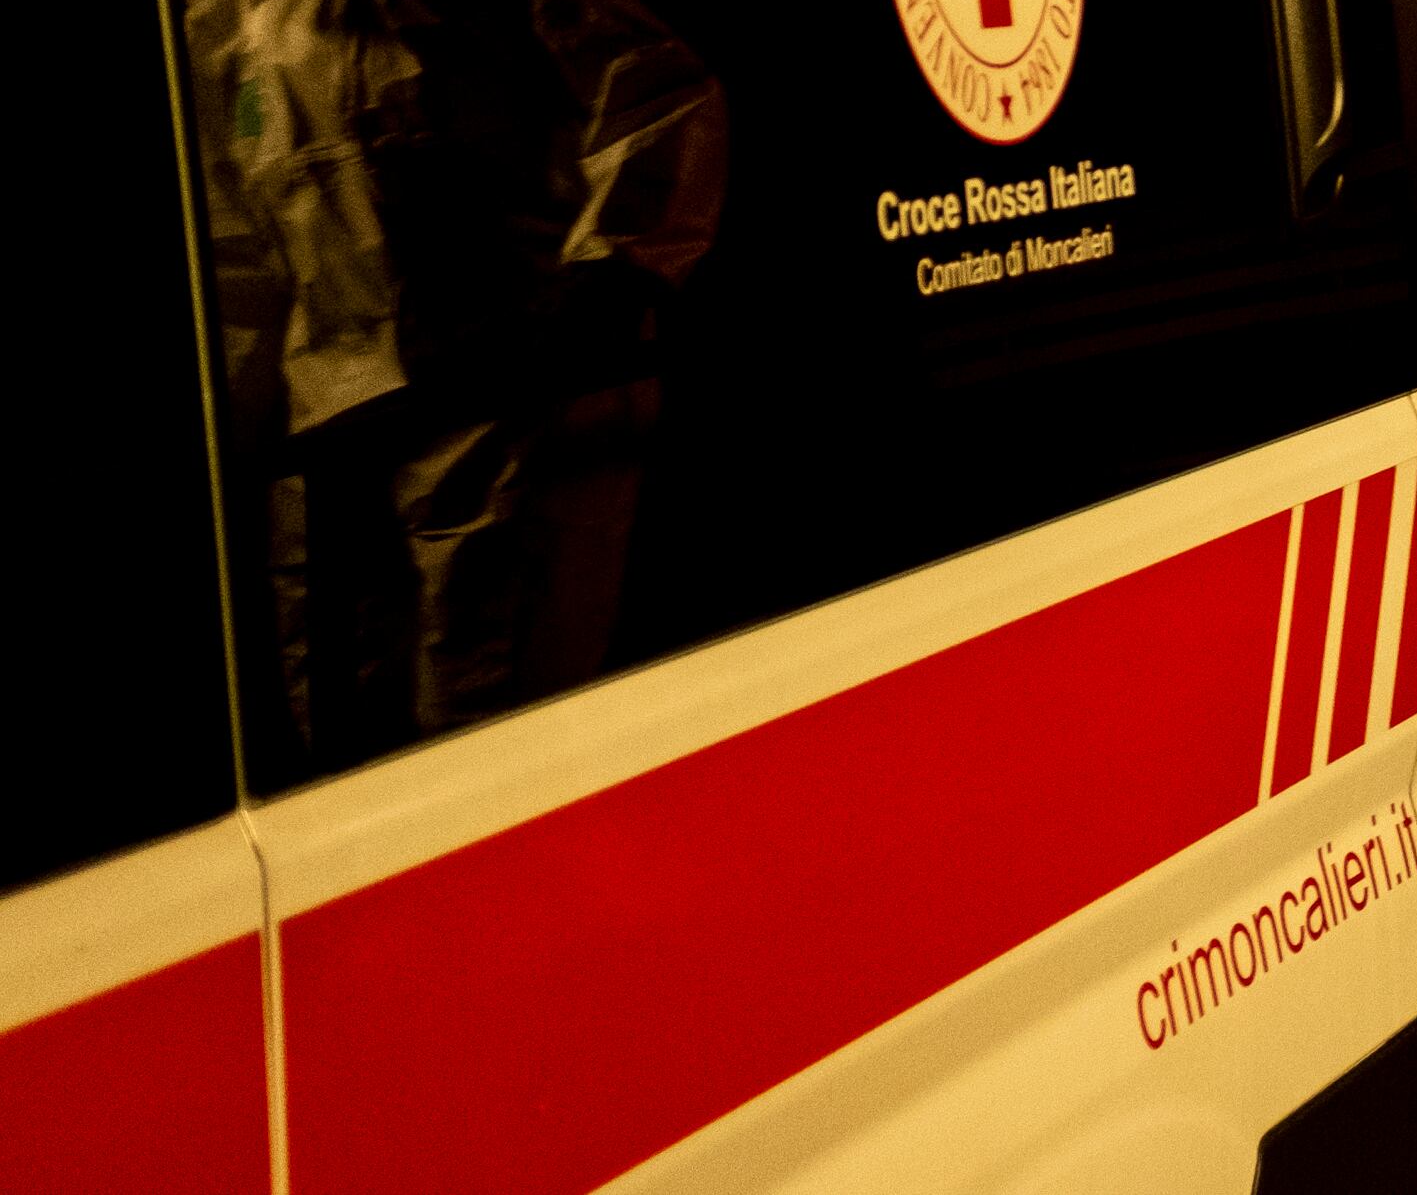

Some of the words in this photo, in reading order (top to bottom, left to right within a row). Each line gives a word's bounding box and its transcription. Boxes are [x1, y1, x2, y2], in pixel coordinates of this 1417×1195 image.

[876, 190, 962, 241] Croce
[963, 176, 1048, 225] Rossa
[1049, 159, 1136, 210] Italiana
[916, 249, 1004, 296] Comitato
[1005, 240, 1025, 277] di
[1025, 223, 1114, 272] Moncalieri
